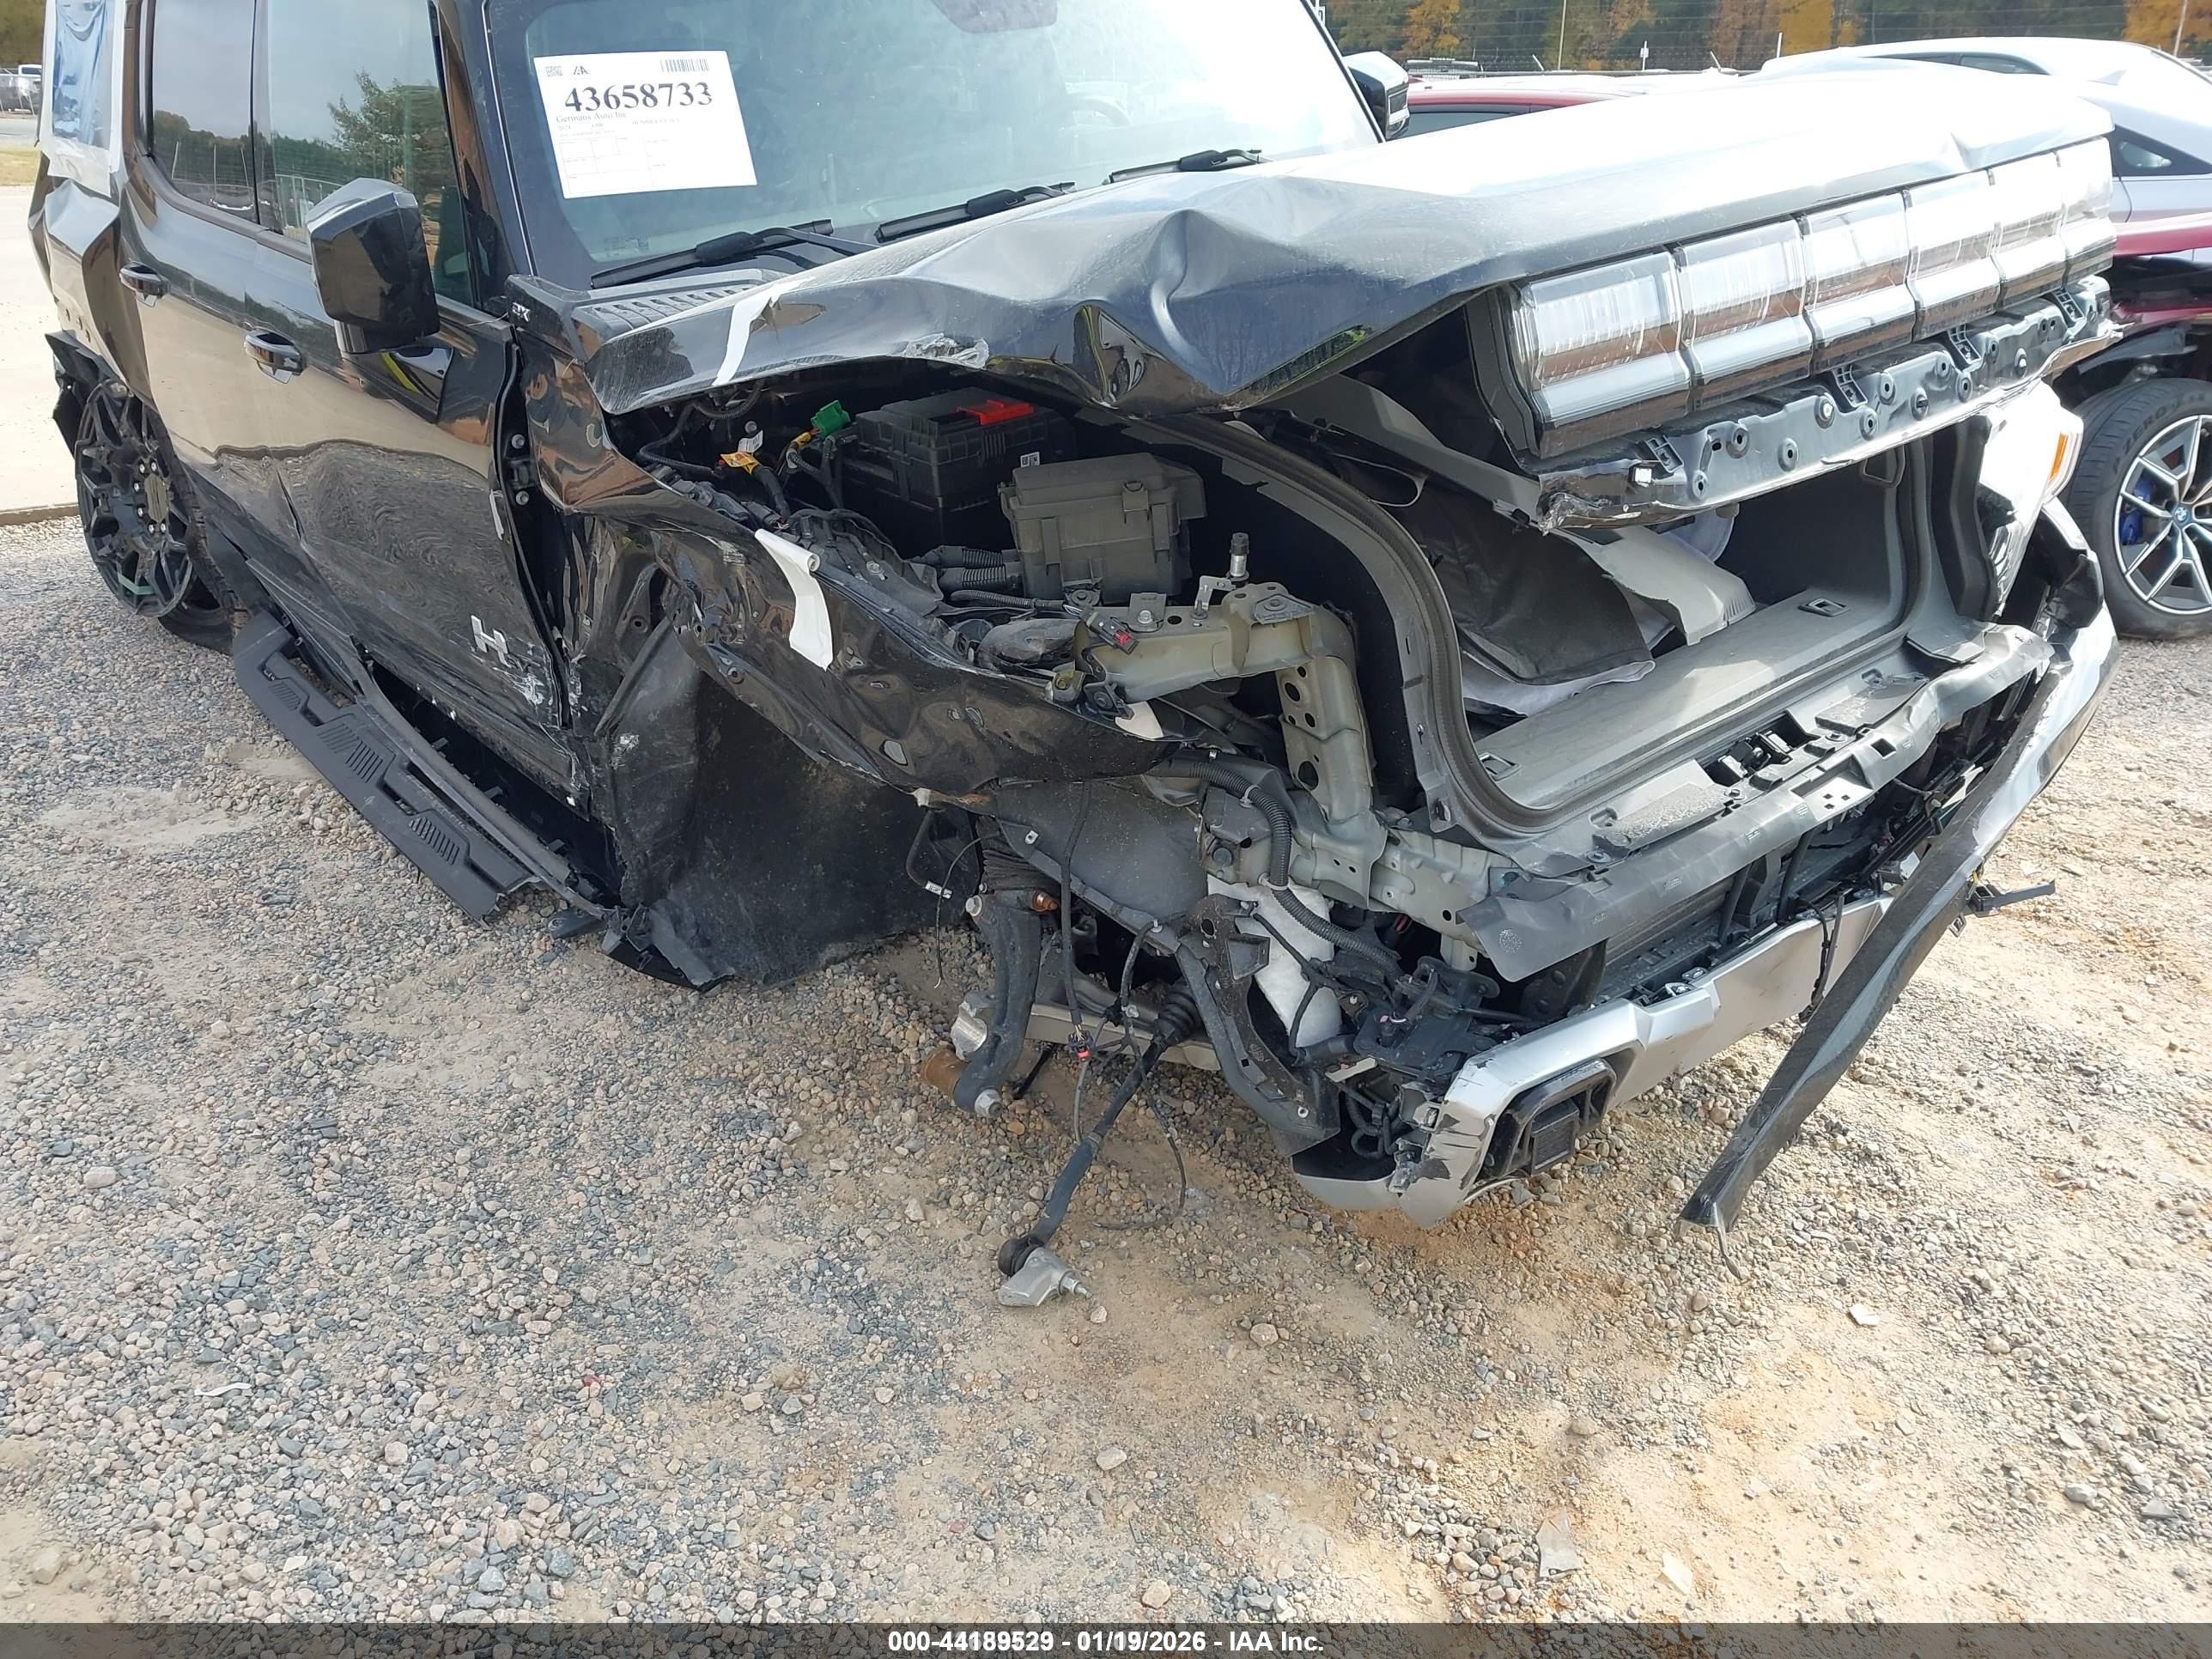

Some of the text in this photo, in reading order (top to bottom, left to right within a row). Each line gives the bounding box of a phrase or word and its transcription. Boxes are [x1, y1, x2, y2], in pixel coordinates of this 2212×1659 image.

[565, 82, 712, 112] 43658733
[556, 112, 592, 123] Germans
[594, 111, 614, 120] Auto
